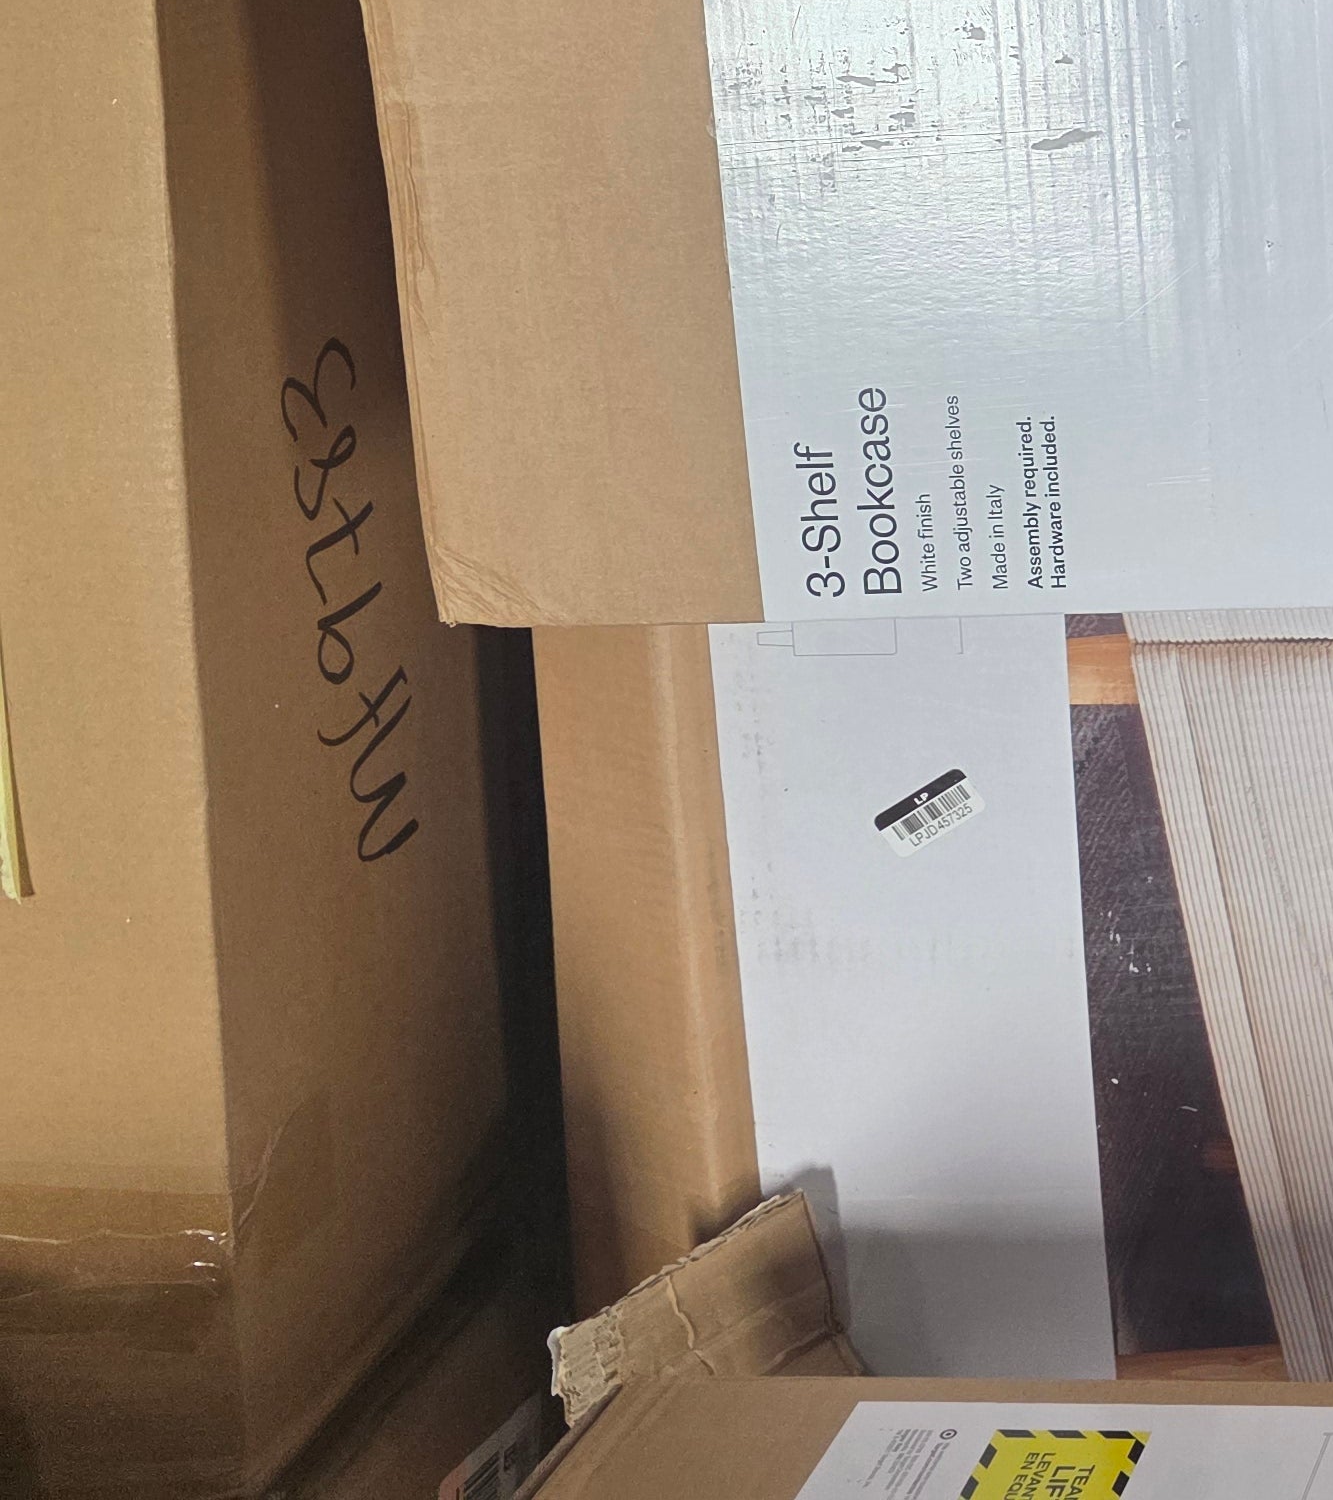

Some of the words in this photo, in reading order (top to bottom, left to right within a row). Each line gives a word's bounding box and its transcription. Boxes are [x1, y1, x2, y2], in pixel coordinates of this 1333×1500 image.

[944, 394, 964, 460] shelves
[1016, 417, 1039, 498] required.
[1039, 417, 1062, 497] included.
[856, 387, 903, 595] Bookcase
[948, 465, 973, 552] adjustable
[986, 484, 1006, 520] Italy
[793, 442, 846, 598] 3-Shelf
[915, 494, 935, 540] finish
[988, 525, 1004, 538] in
[919, 543, 938, 591] White
[990, 543, 1008, 590] Made
[1022, 502, 1044, 588] Assembly
[1046, 502, 1067, 588] Hardware
[957, 557, 973, 590] Two
[914, 792, 929, 805] LP
[908, 803, 973, 847] LPJD457325
[1020, 1452, 1041, 1470] EN
[1045, 1466, 1077, 1500] LIF
